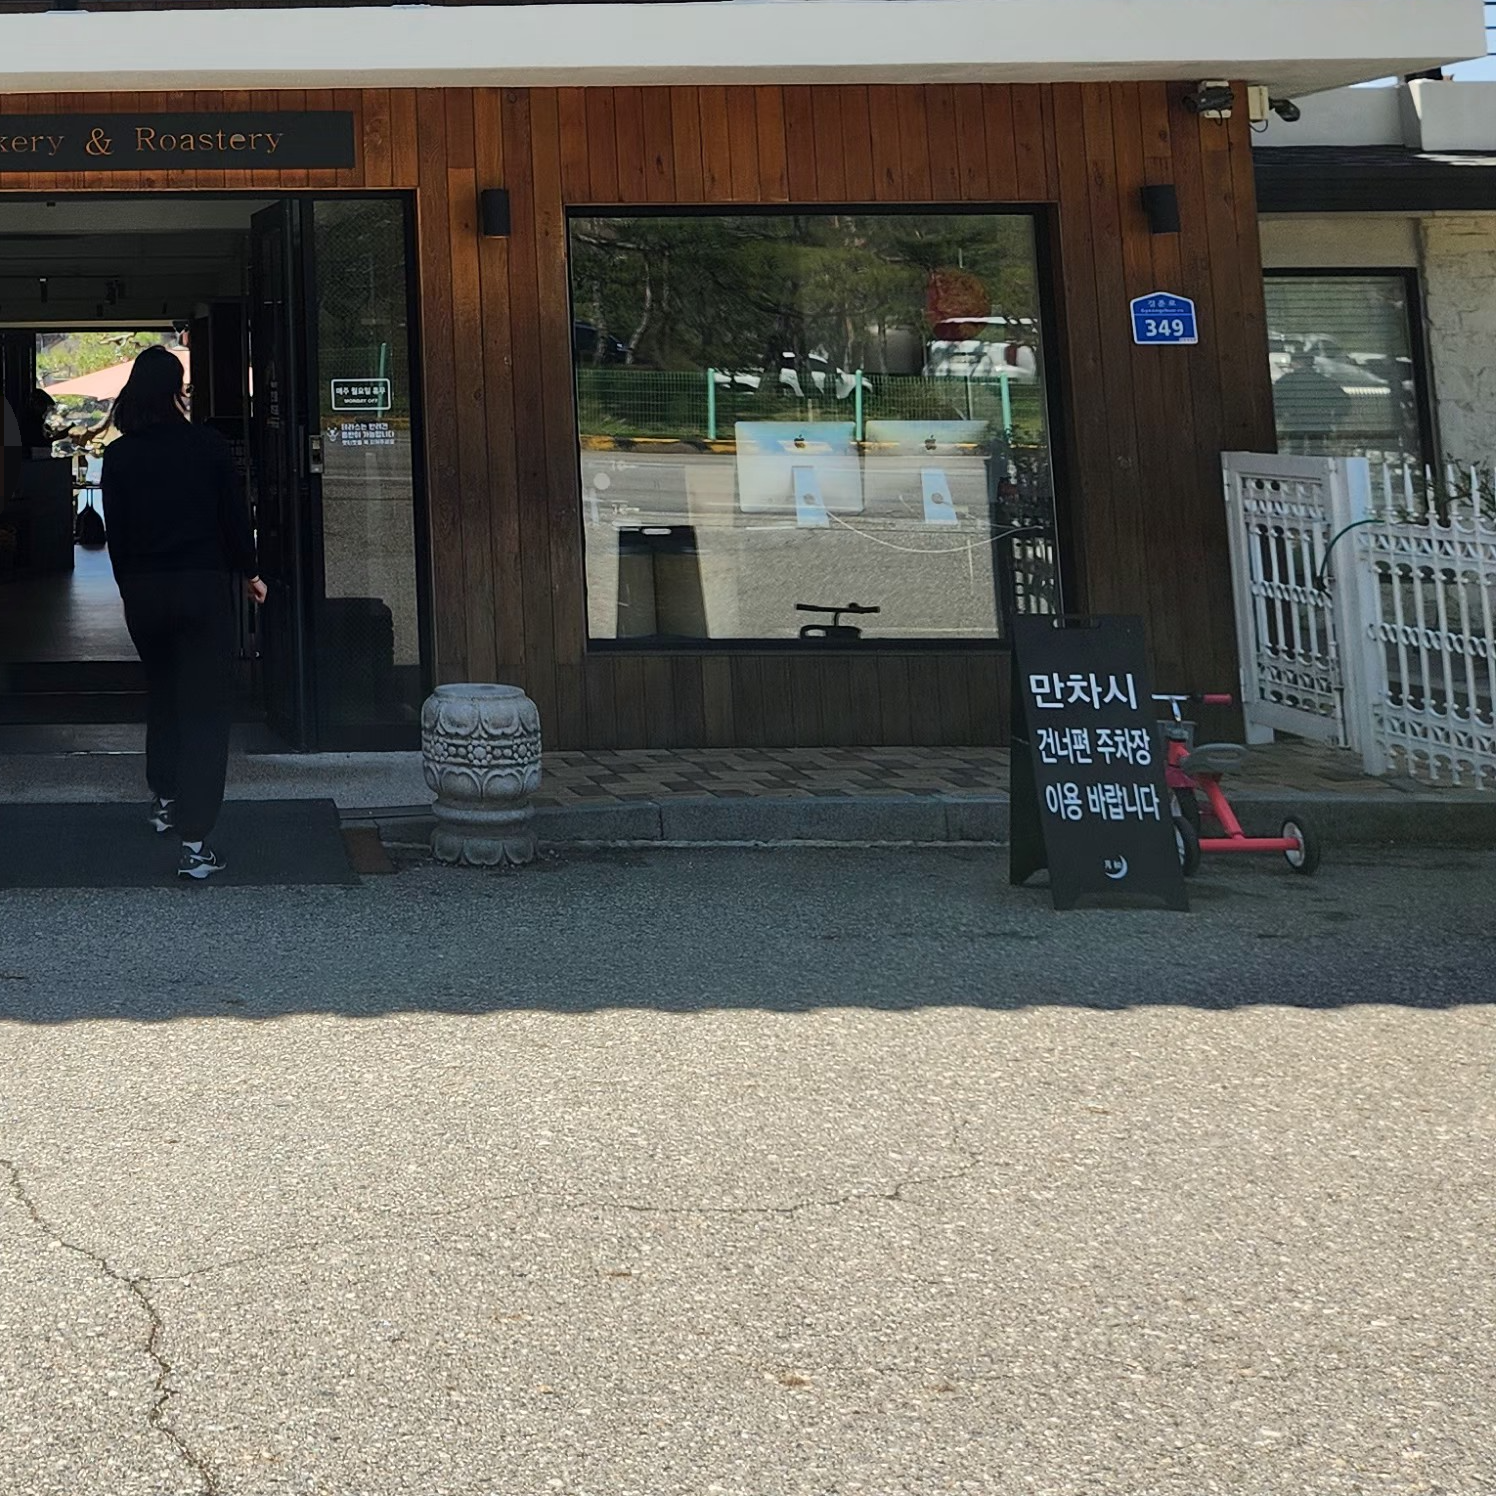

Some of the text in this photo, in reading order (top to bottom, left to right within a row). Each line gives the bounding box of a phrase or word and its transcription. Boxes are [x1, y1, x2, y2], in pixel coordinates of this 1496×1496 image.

[85, 127, 113, 156] &
[134, 126, 284, 154] Roastery
[1145, 319, 1184, 337] 349
[335, 386, 386, 396] 매주 월요일 휴무
[1029, 672, 1138, 710] 만차시
[1036, 727, 1152, 765] 건너편 주차장
[1045, 782, 1161, 822] 이용 바랍니다
